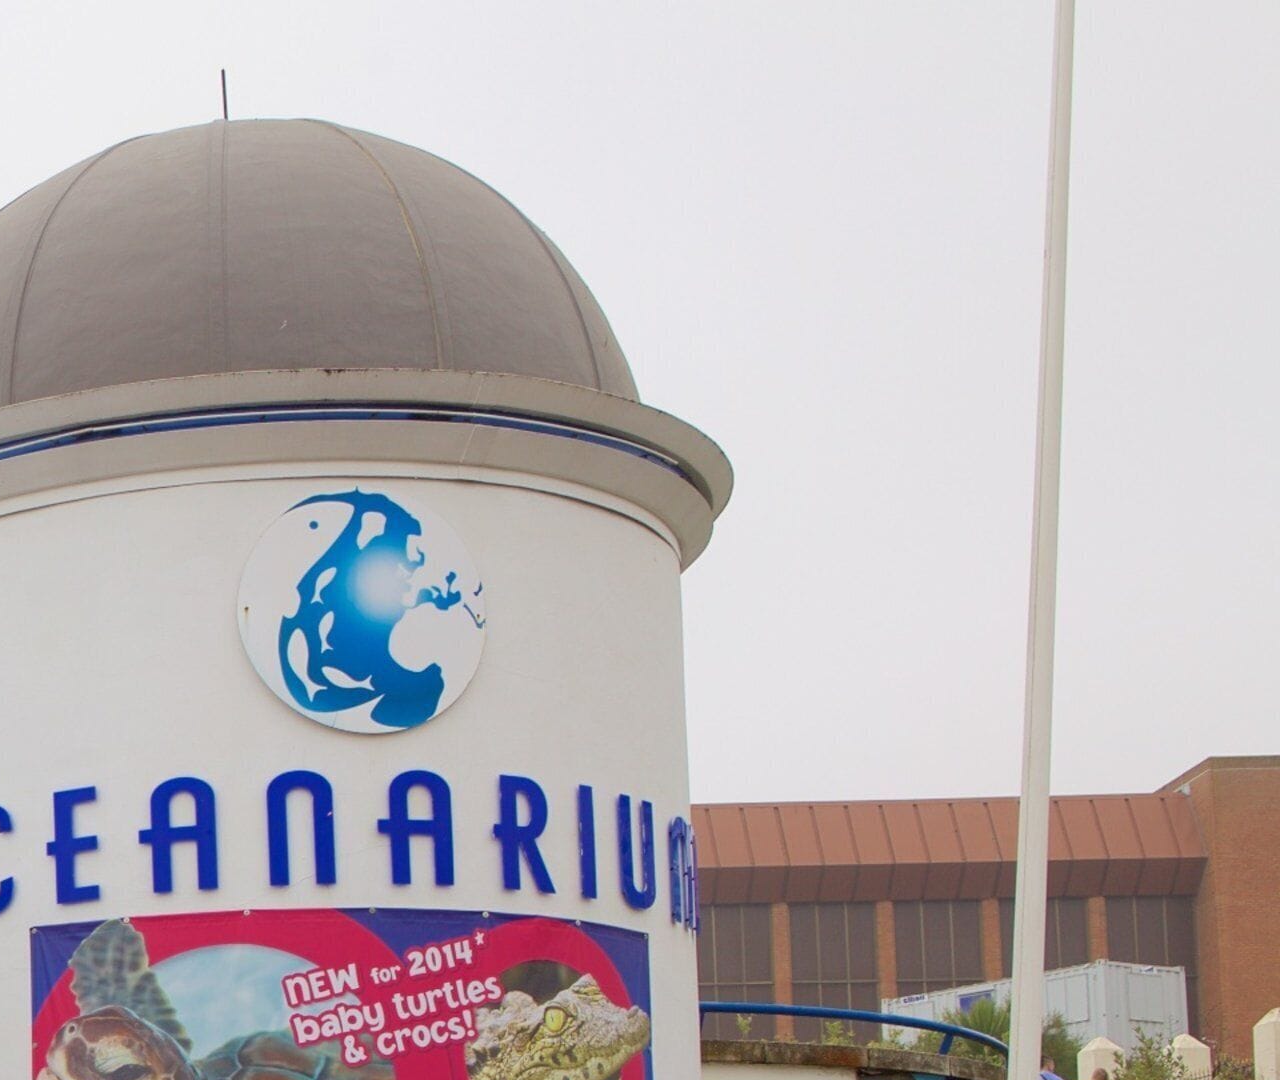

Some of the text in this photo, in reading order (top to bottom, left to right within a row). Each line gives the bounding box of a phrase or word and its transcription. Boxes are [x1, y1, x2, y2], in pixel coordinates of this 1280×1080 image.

[285, 963, 359, 1005] NEW
[370, 965, 400, 984] for
[293, 976, 502, 1044] baby turtles
[344, 1009, 476, 1063] & crocs!
